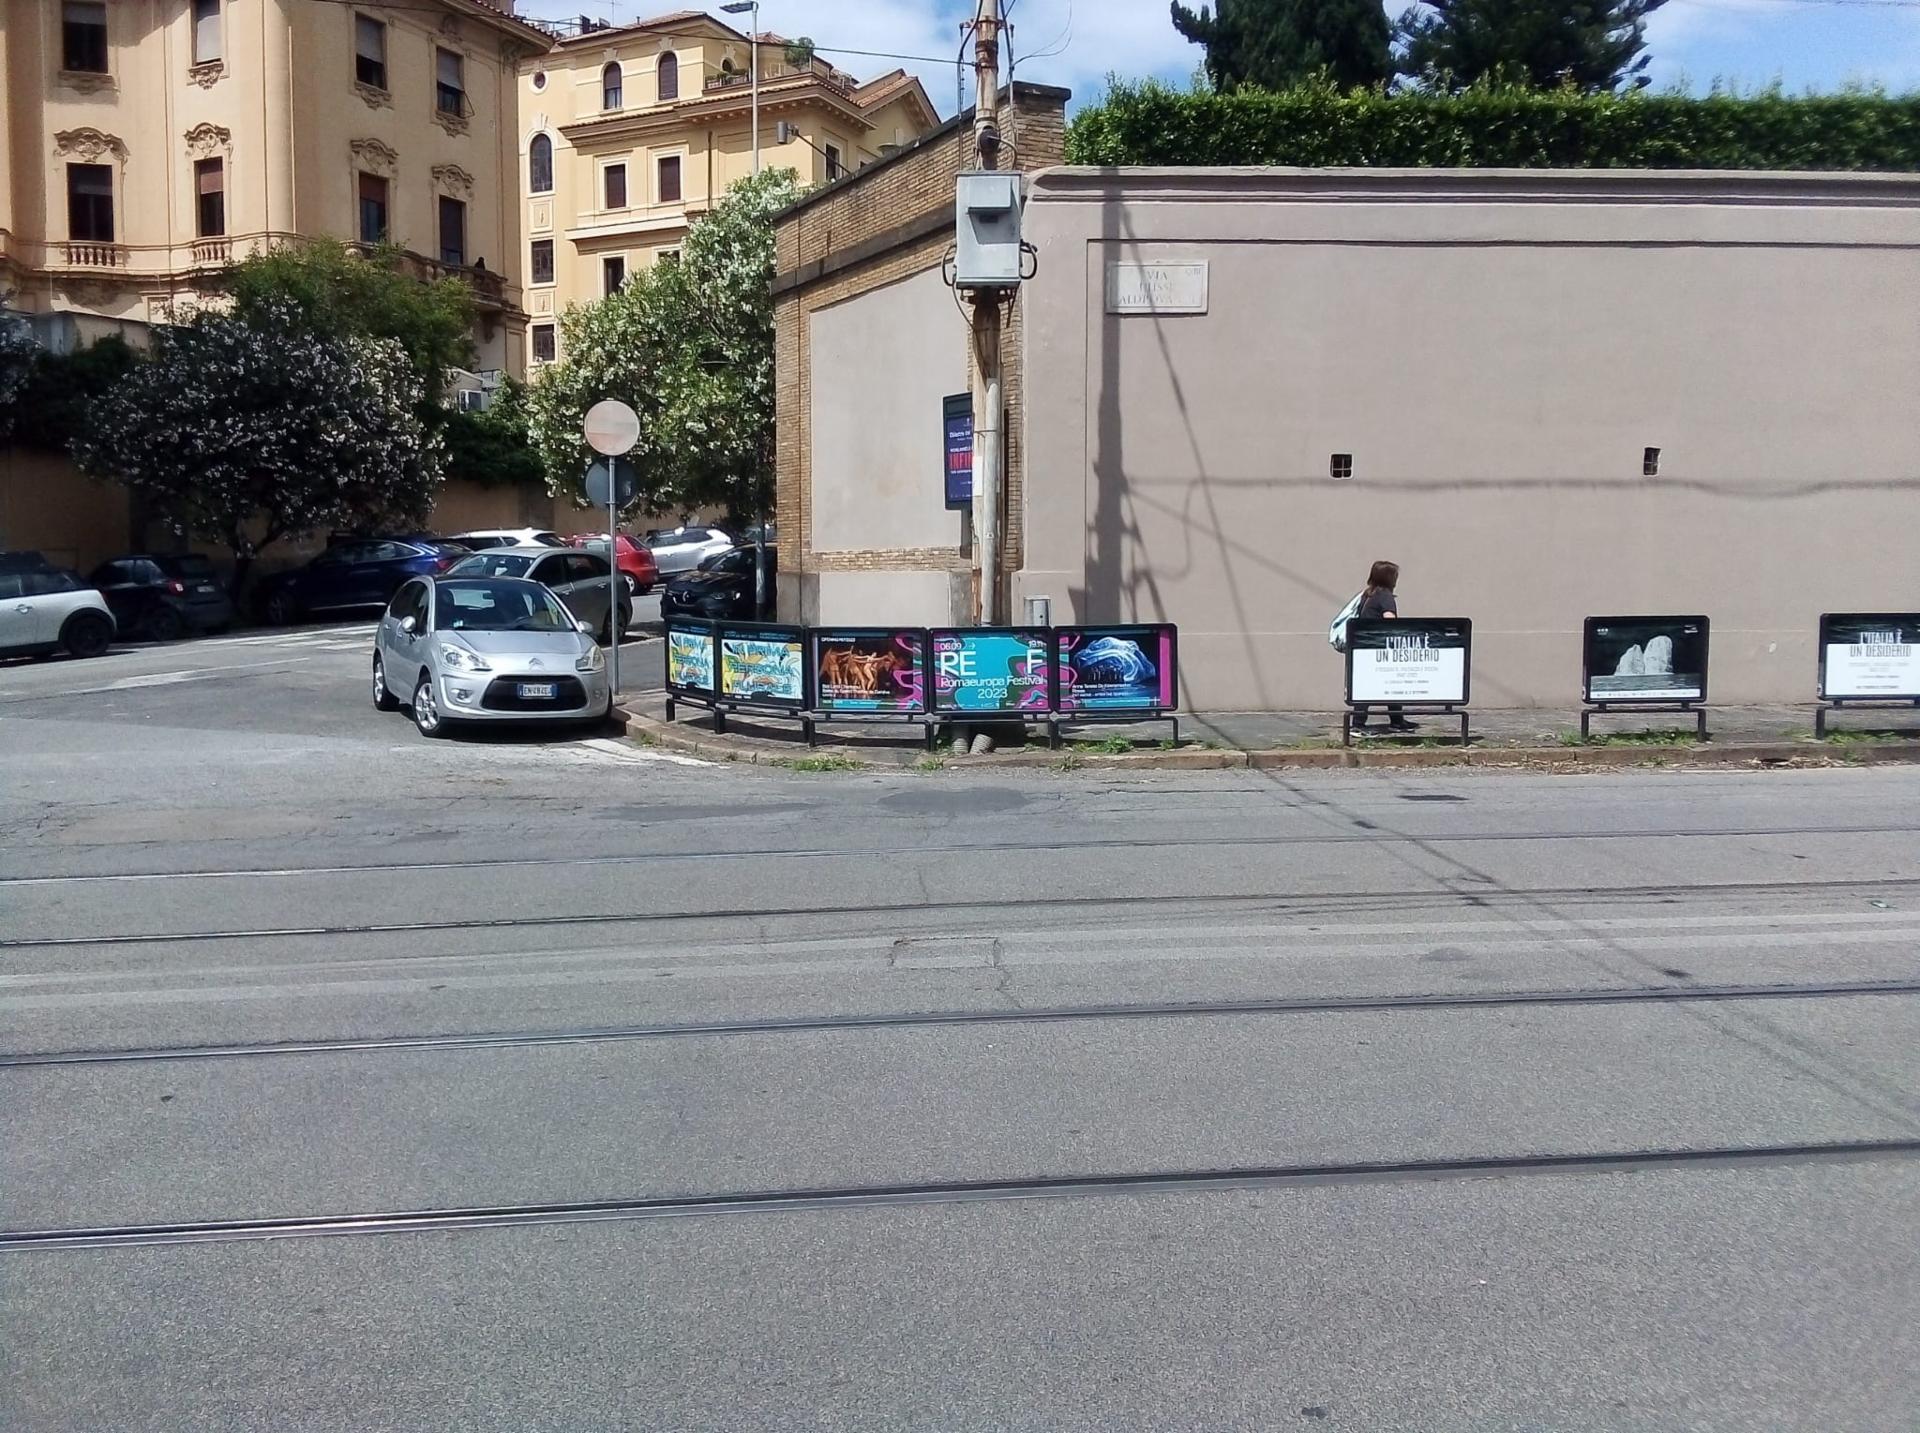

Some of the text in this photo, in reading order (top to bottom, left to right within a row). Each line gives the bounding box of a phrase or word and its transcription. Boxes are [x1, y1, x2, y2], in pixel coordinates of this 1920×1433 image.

[1147, 271, 1168, 280] VIA
[1386, 636, 1421, 649] L'ITALIA
[1860, 632, 1894, 644] L'ITALIA
[940, 643, 962, 651] 06.09
[1850, 645, 1911, 657] UN DESIDERIO
[1376, 649, 1440, 662] UN DESIDERIO
[940, 649, 1043, 676] RE F
[940, 675, 1044, 689] Romaeuropa Festival
[977, 688, 1008, 699] 2023
